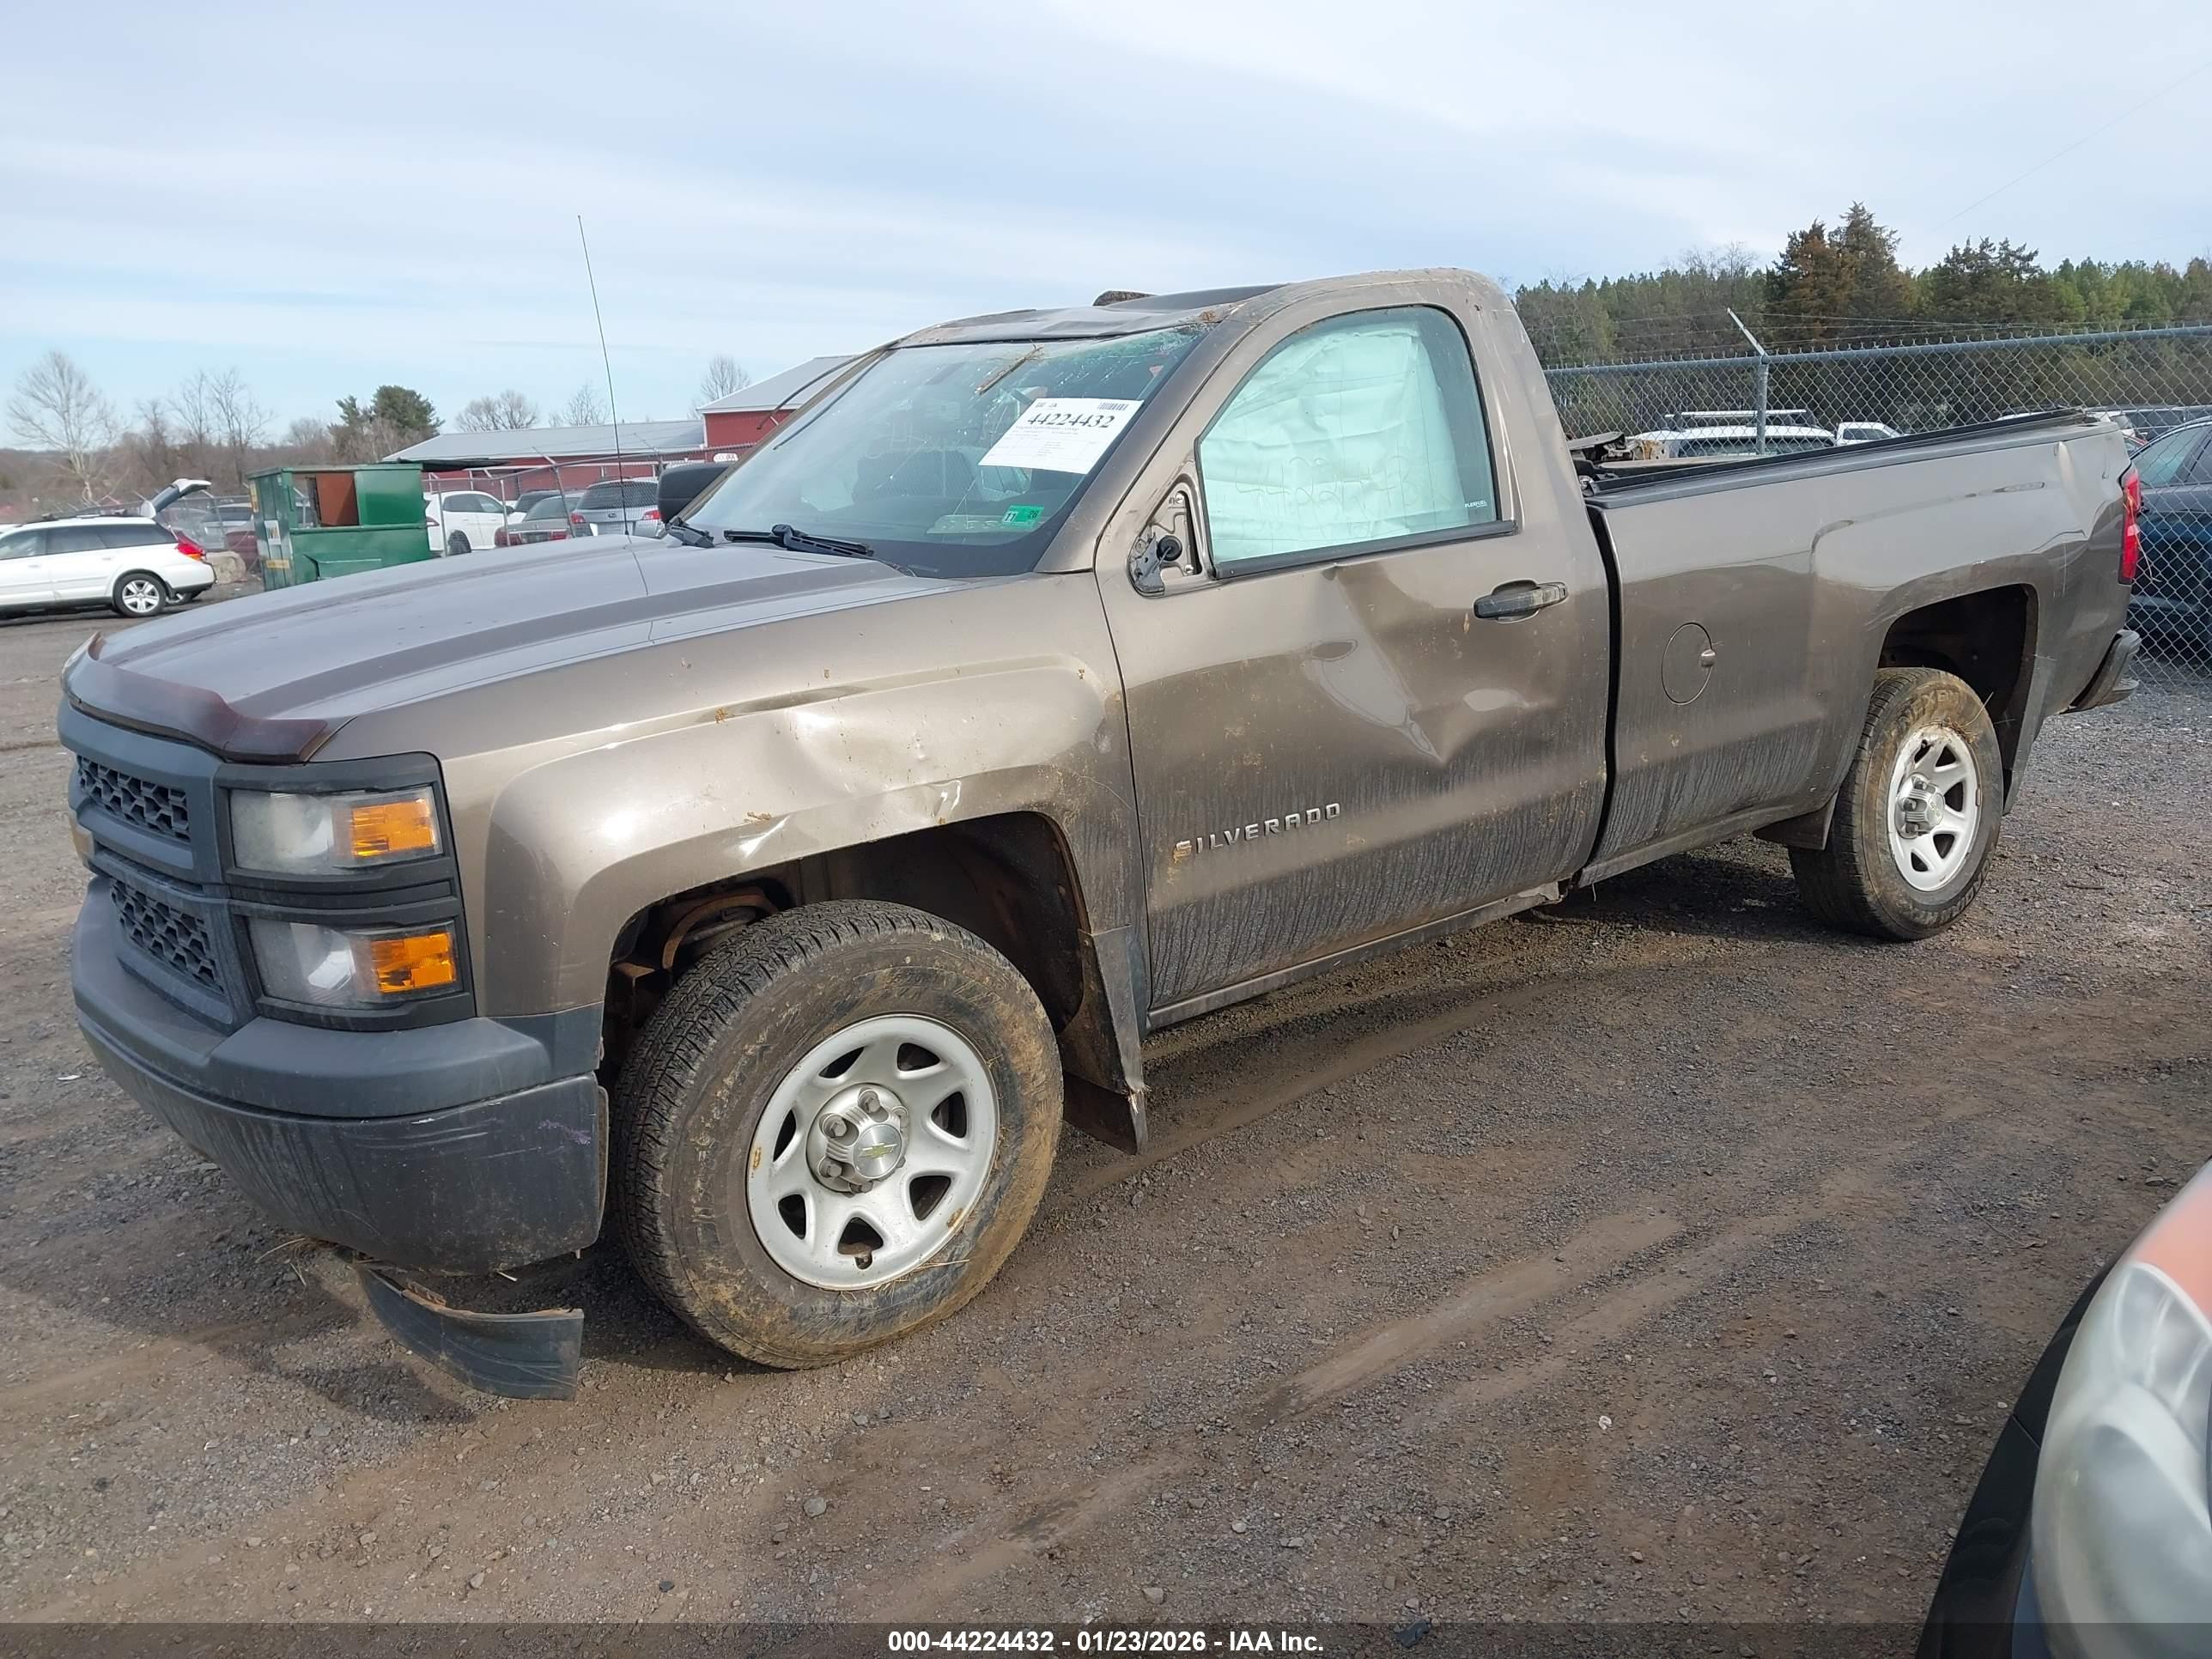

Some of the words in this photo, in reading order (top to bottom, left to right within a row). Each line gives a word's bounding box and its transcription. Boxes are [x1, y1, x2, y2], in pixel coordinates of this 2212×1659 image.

[1027, 412, 1115, 428] 44224432
[1005, 513, 1017, 522] 11
[1173, 803, 1340, 859] SILVERADO
